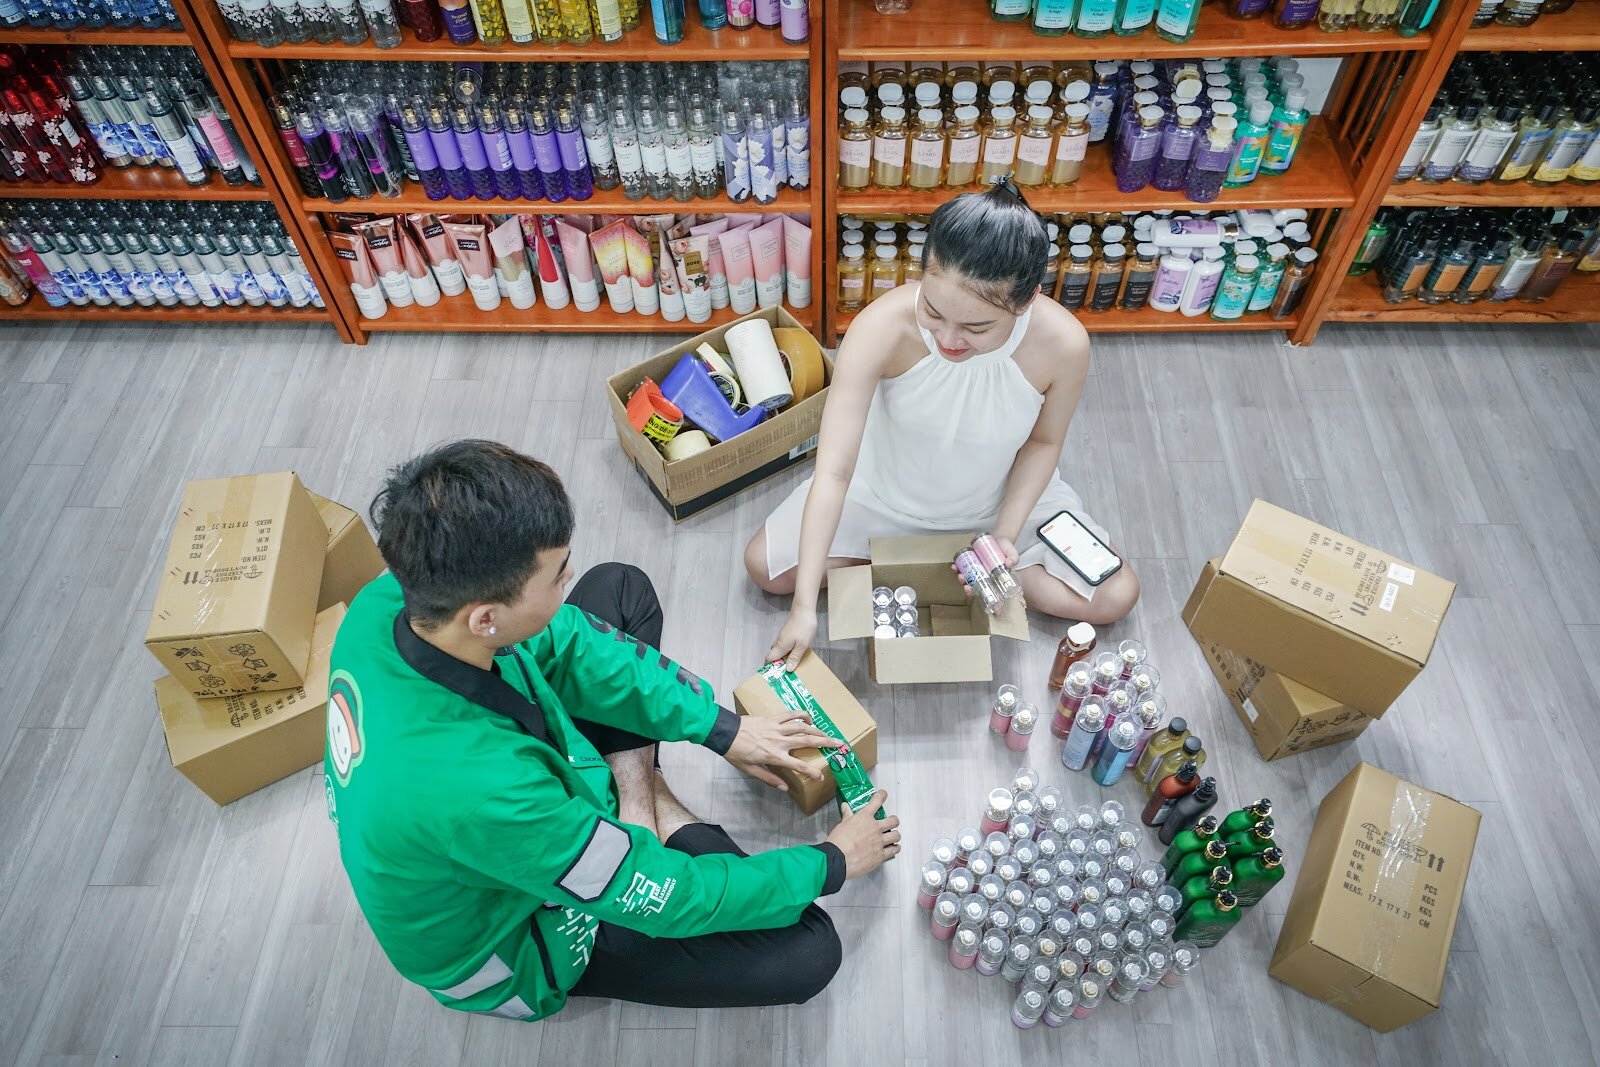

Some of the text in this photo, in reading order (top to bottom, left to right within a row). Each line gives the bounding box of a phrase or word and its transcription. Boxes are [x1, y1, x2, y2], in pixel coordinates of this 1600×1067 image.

[1355, 839, 1371, 851] ITEM
[1424, 884, 1438, 895] PCS
[1422, 895, 1435, 906] KGS
[1368, 894, 1376, 902] 17
[1377, 897, 1382, 906] X
[1387, 903, 1394, 911] 17
[1404, 911, 1411, 919] 31
[1419, 919, 1430, 928] CM
[1419, 905, 1432, 917] KGS
